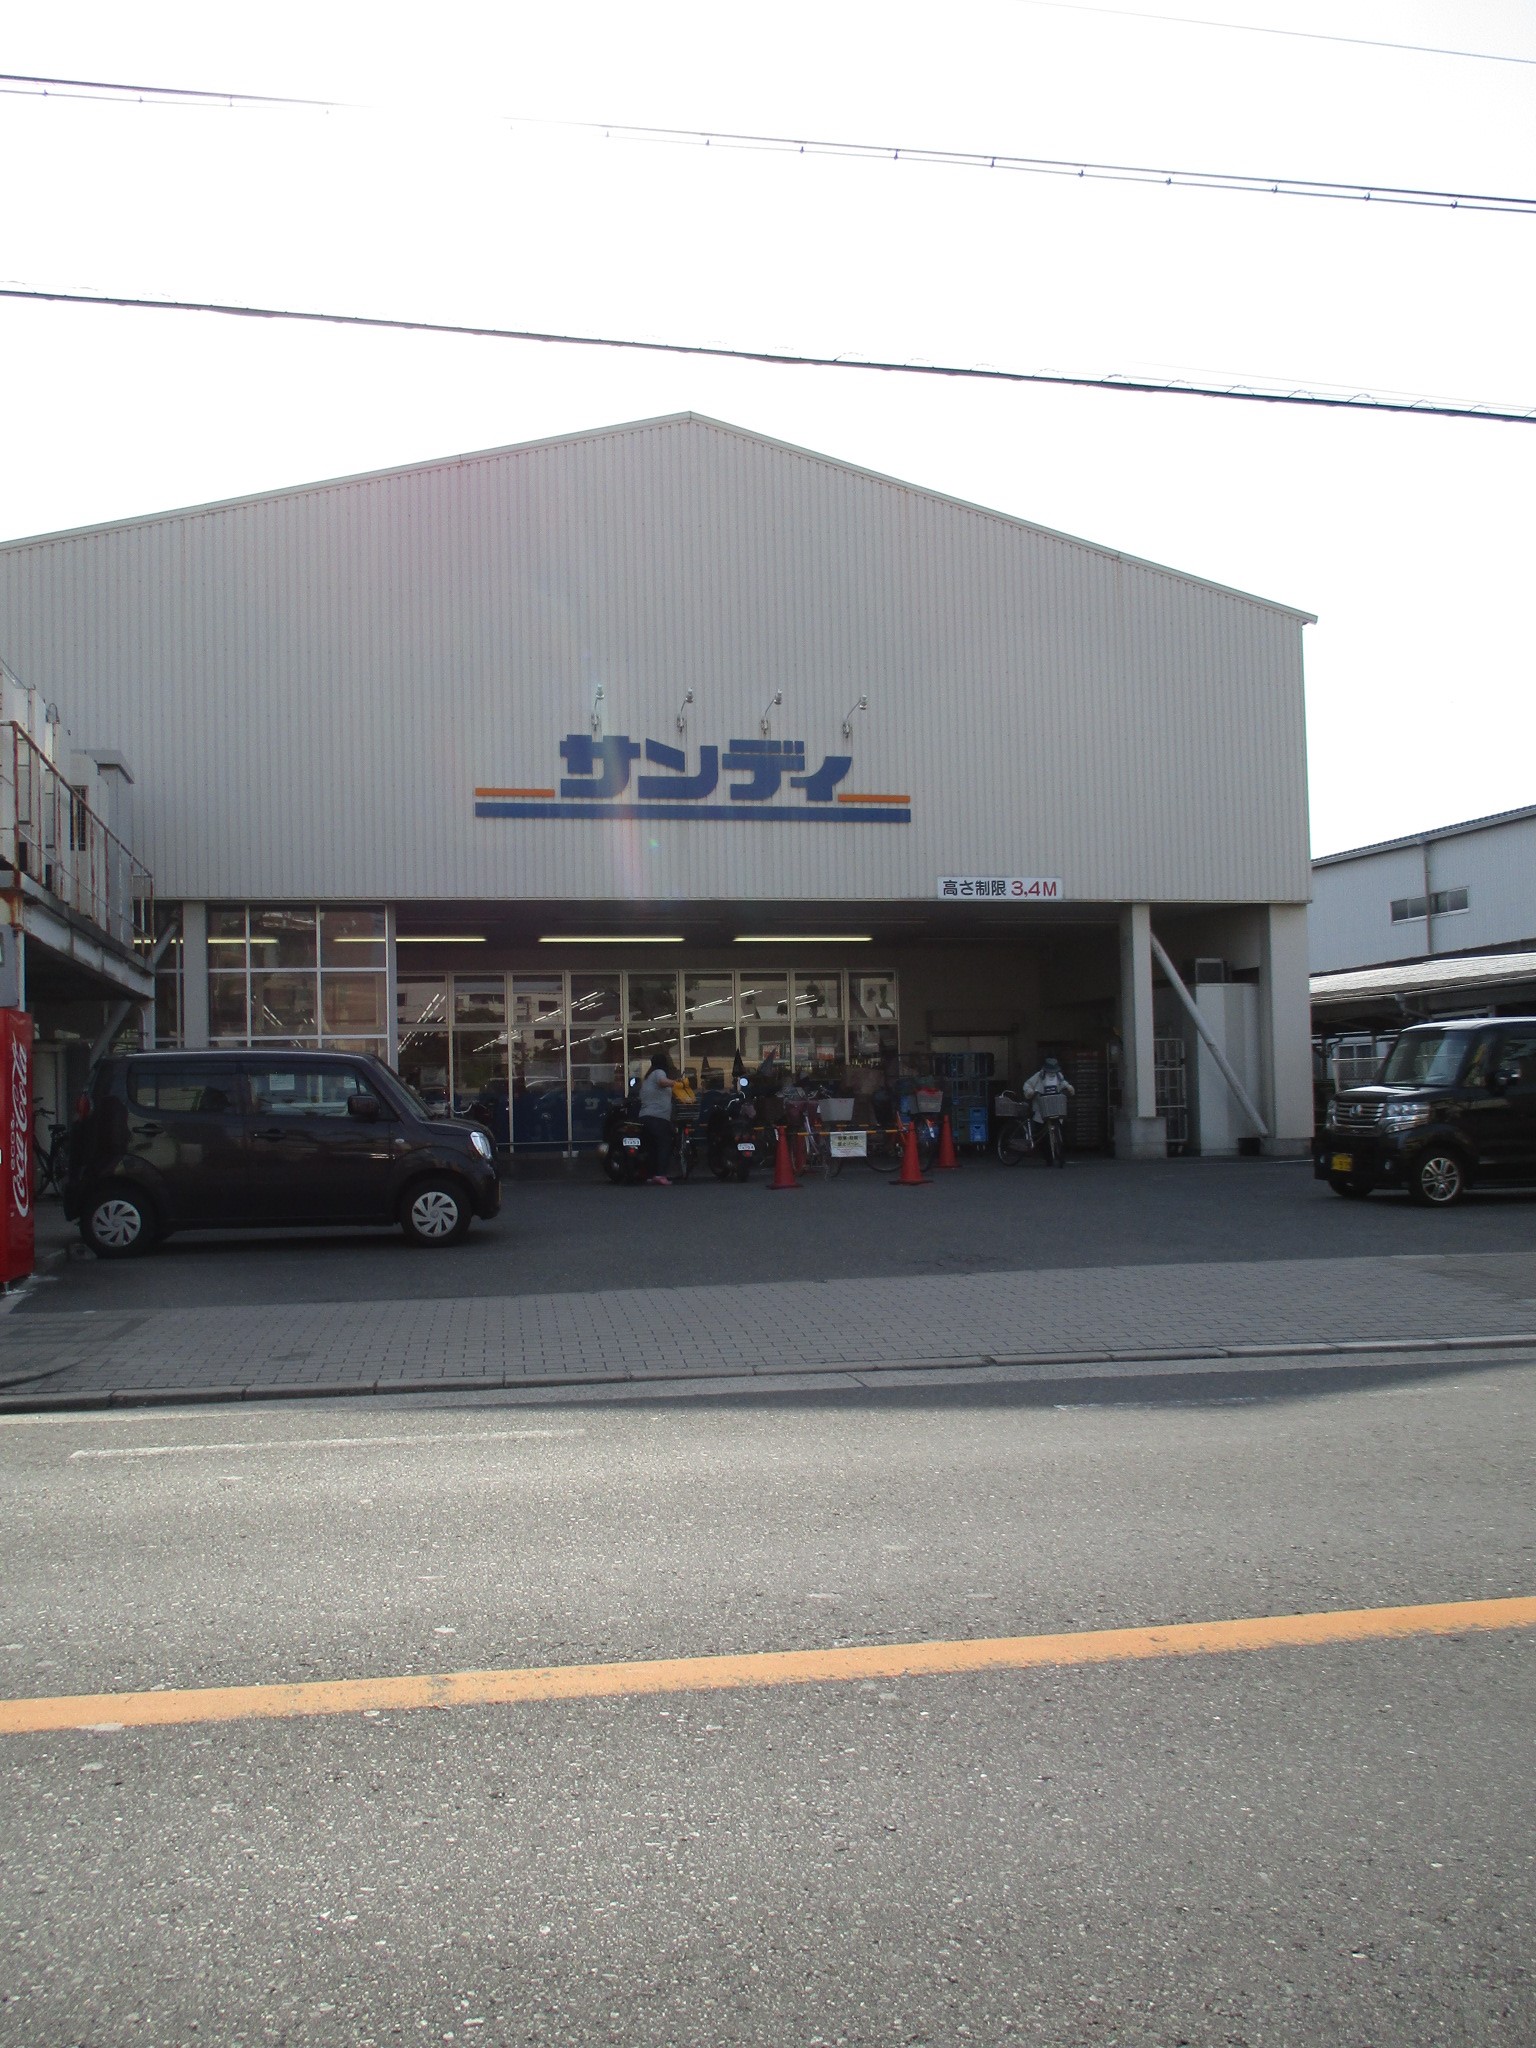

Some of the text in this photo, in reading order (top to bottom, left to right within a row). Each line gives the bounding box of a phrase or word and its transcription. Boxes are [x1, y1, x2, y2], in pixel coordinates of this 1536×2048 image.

[559, 735, 852, 802] サンディ
[943, 880, 1006, 896] 高さ制限
